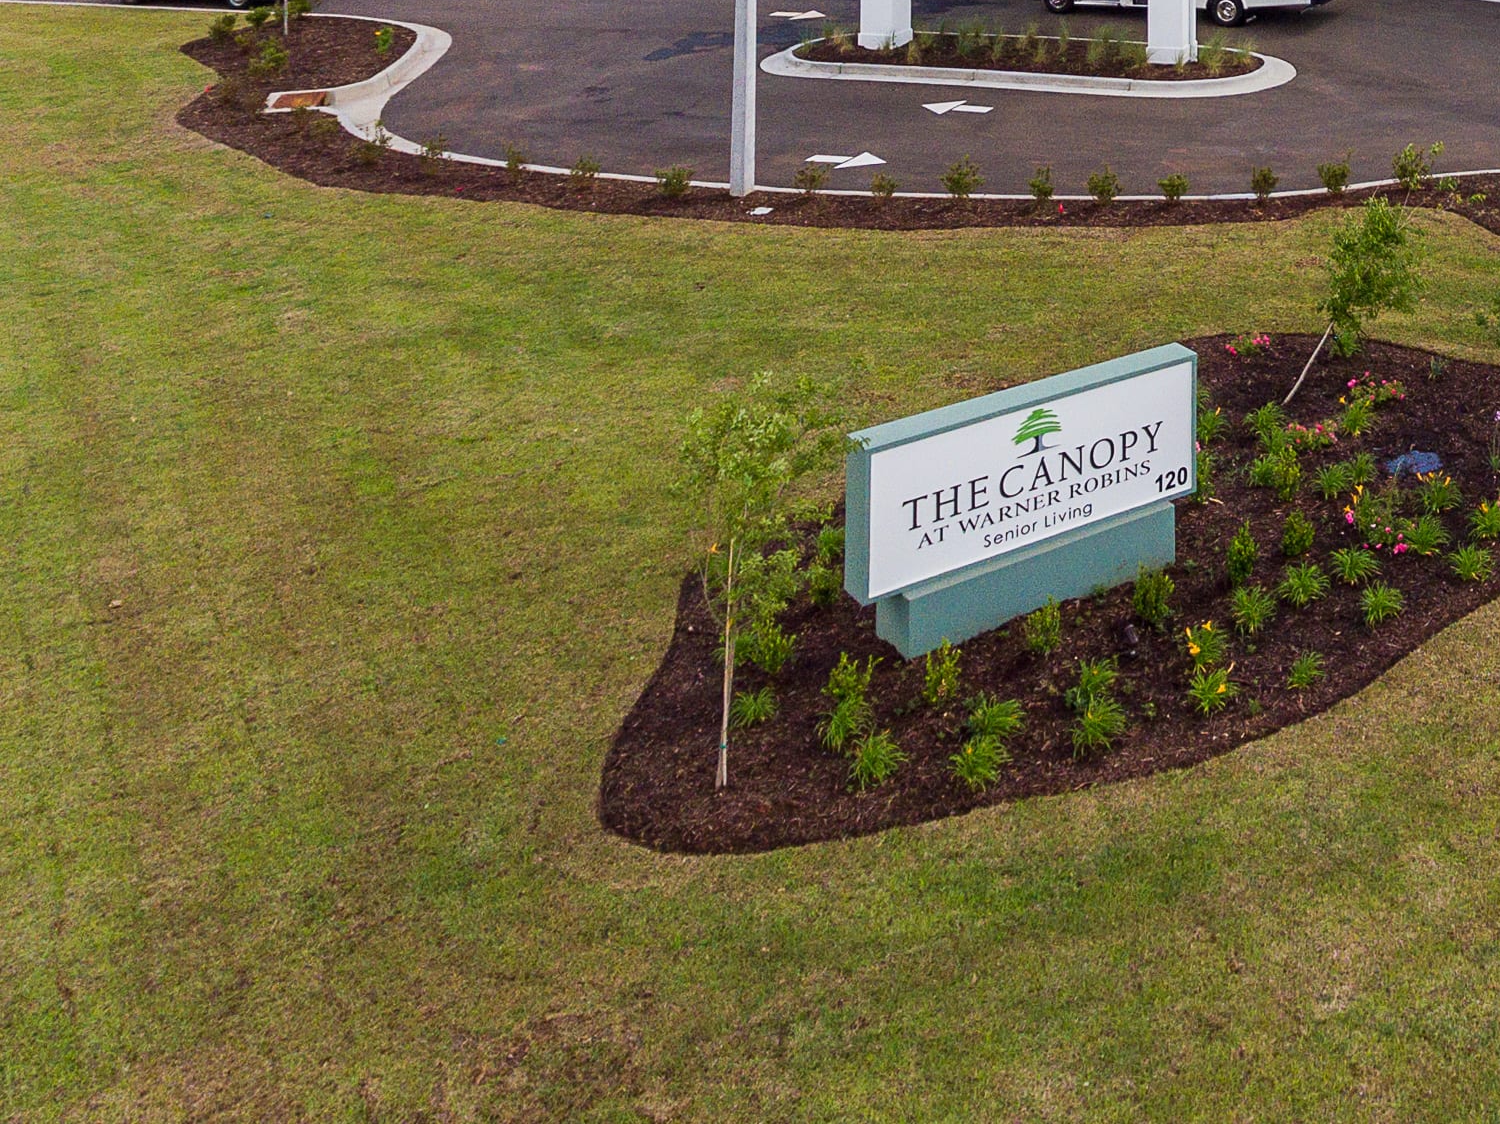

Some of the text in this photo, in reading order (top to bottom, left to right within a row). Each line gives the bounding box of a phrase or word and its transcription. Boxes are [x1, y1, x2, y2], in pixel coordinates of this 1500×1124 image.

[901, 420, 1164, 532] THE CANOPY
[917, 459, 1151, 551] AT WARNER ROBINS
[1154, 466, 1188, 494] 120
[982, 502, 1093, 549] Senior Living
